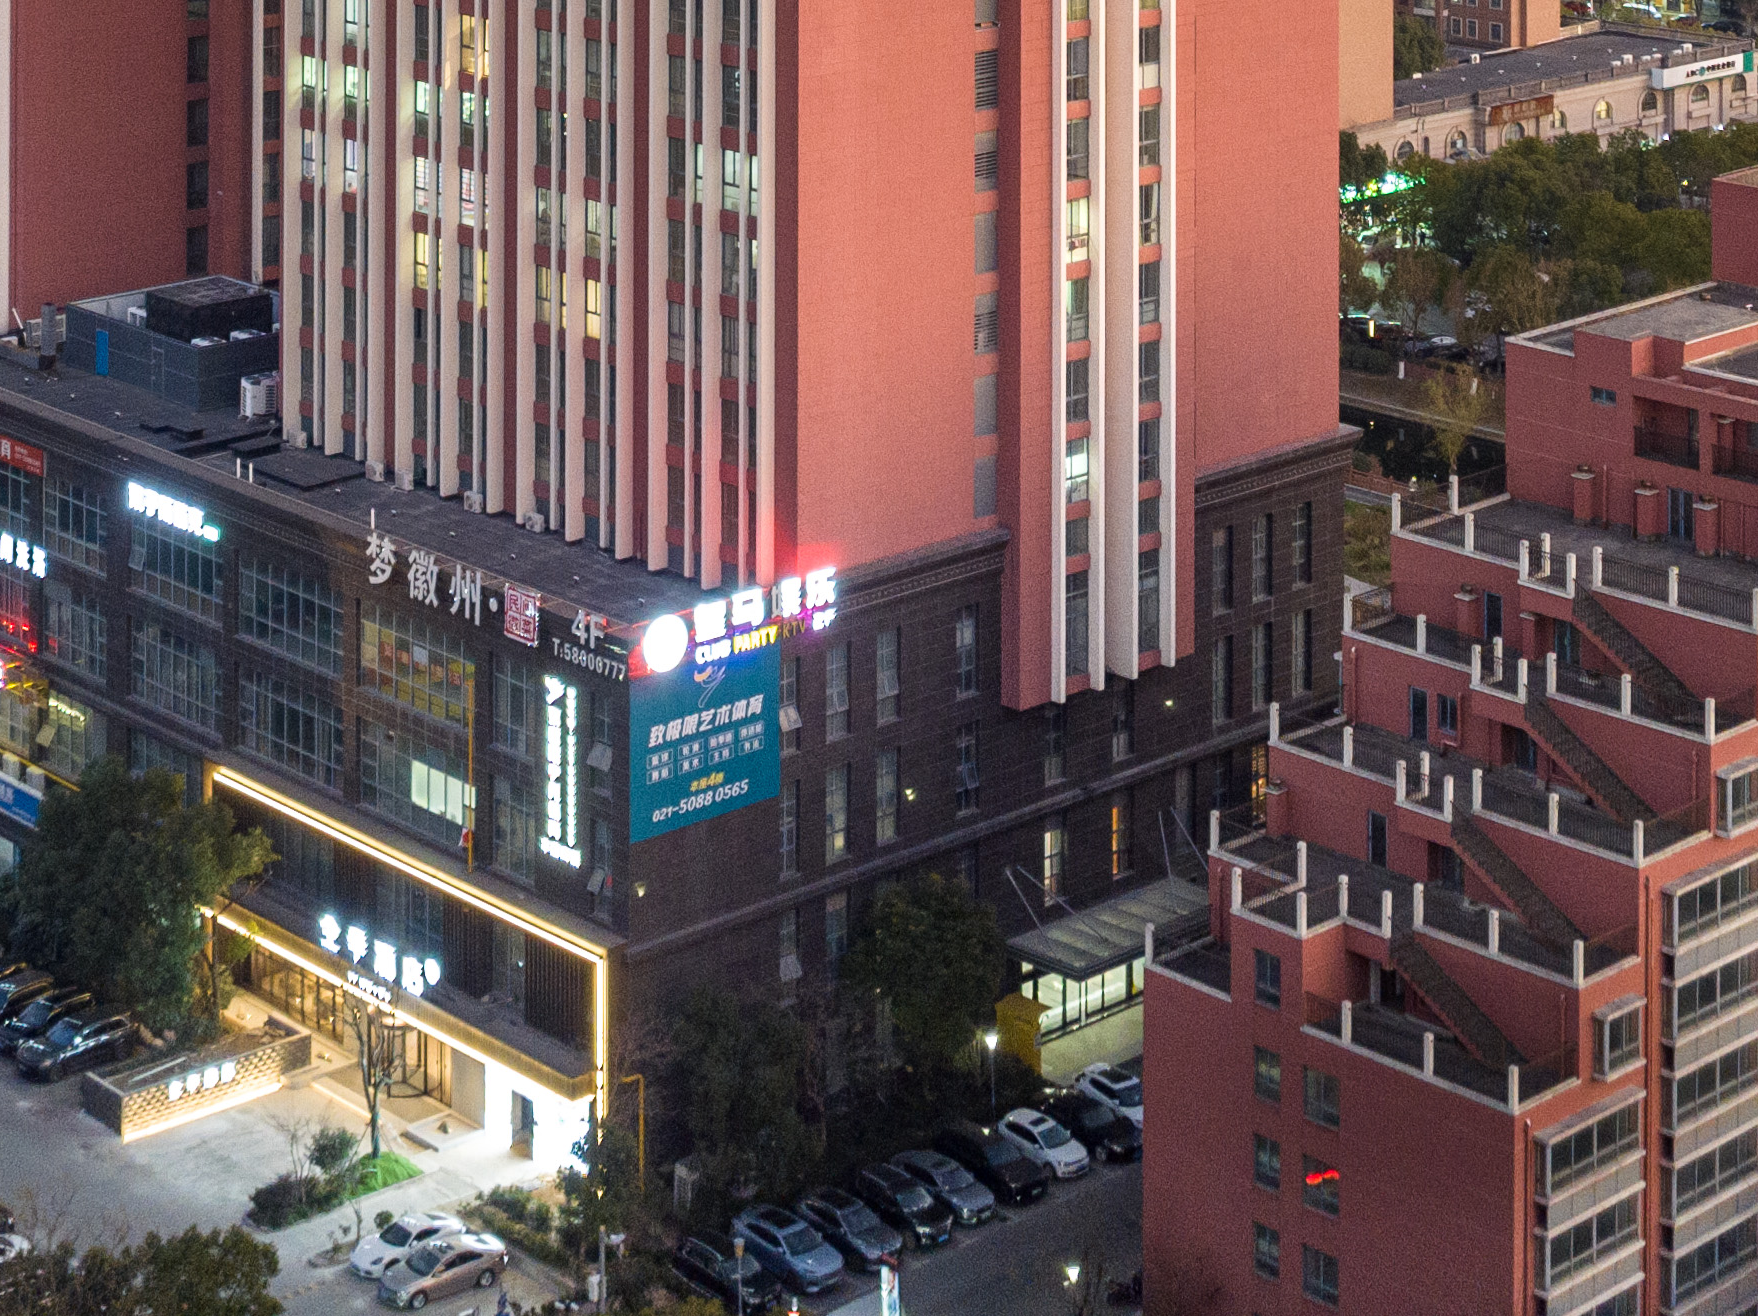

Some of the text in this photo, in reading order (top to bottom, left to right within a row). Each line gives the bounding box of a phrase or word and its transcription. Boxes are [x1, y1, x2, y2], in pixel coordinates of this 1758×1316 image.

[571, 609, 607, 649] 4F
[733, 624, 779, 655] PARTY
[782, 618, 806, 639] KTV
[648, 694, 764, 748] 致极限艺术体育
[714, 779, 750, 802] 0565
